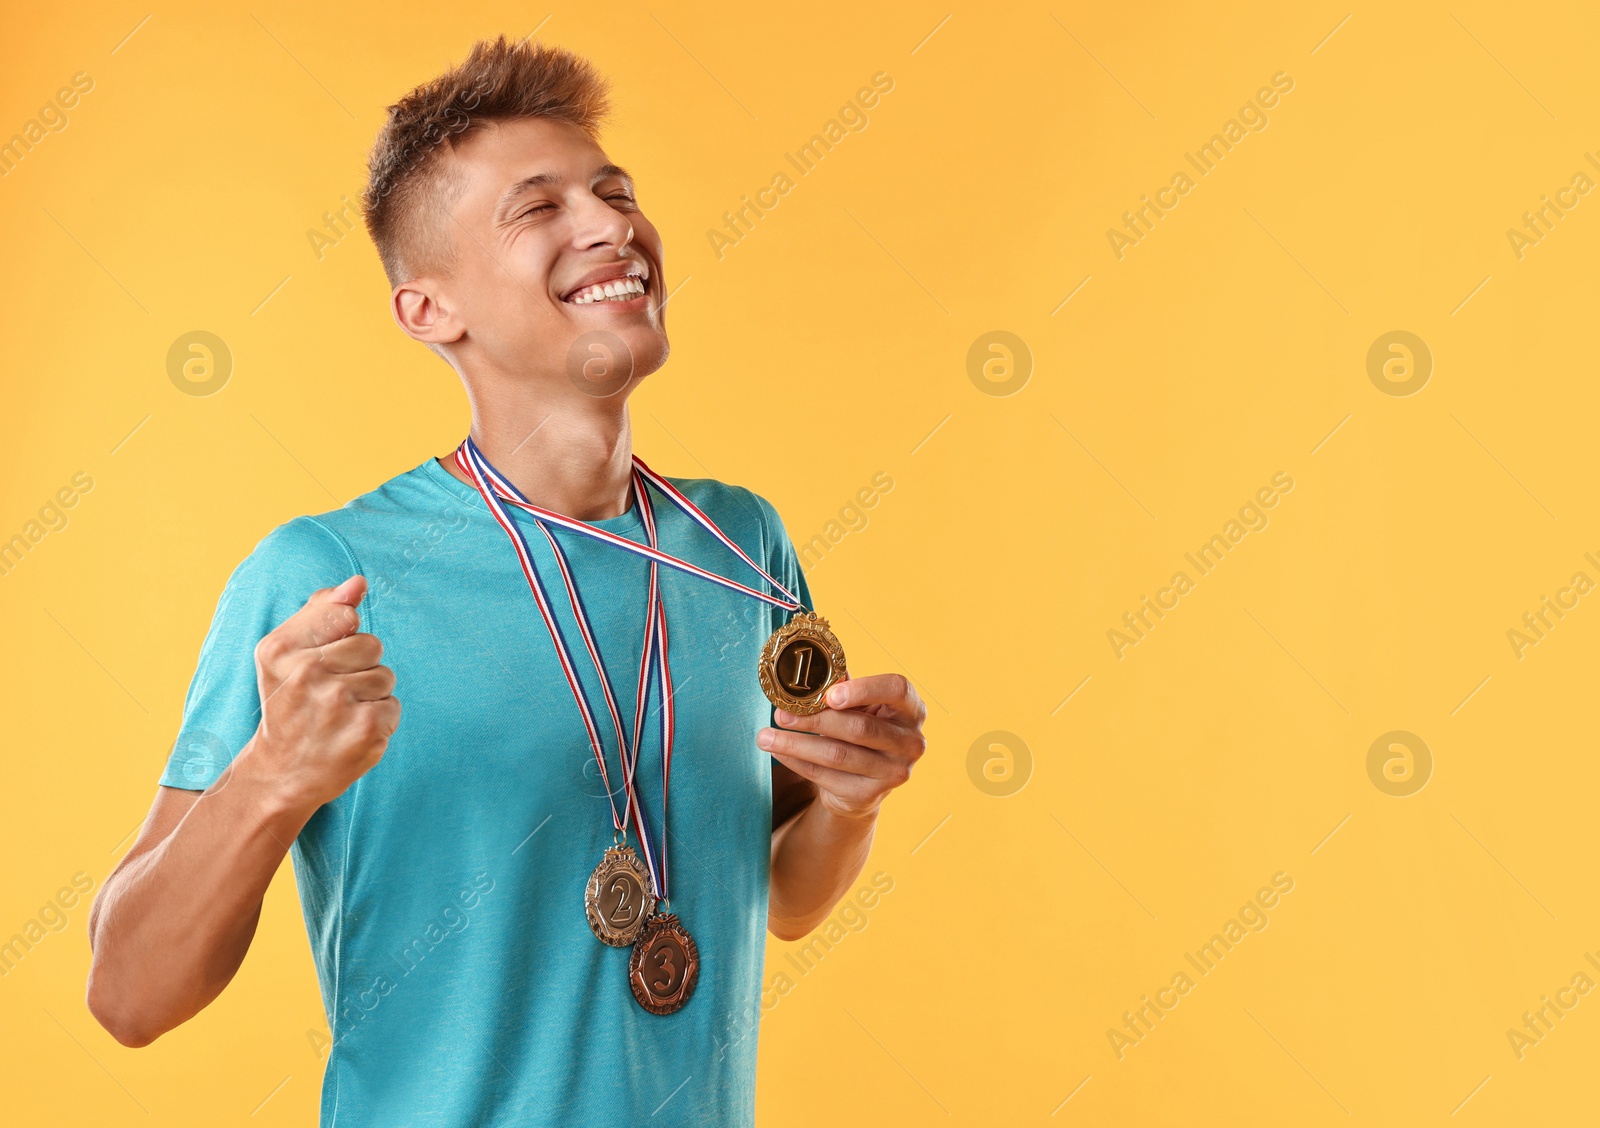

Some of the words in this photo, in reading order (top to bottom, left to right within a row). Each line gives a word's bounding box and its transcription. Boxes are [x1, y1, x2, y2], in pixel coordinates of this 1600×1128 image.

[789, 647, 813, 690] 1
[610, 877, 633, 923] 2
[653, 947, 676, 991] 3
